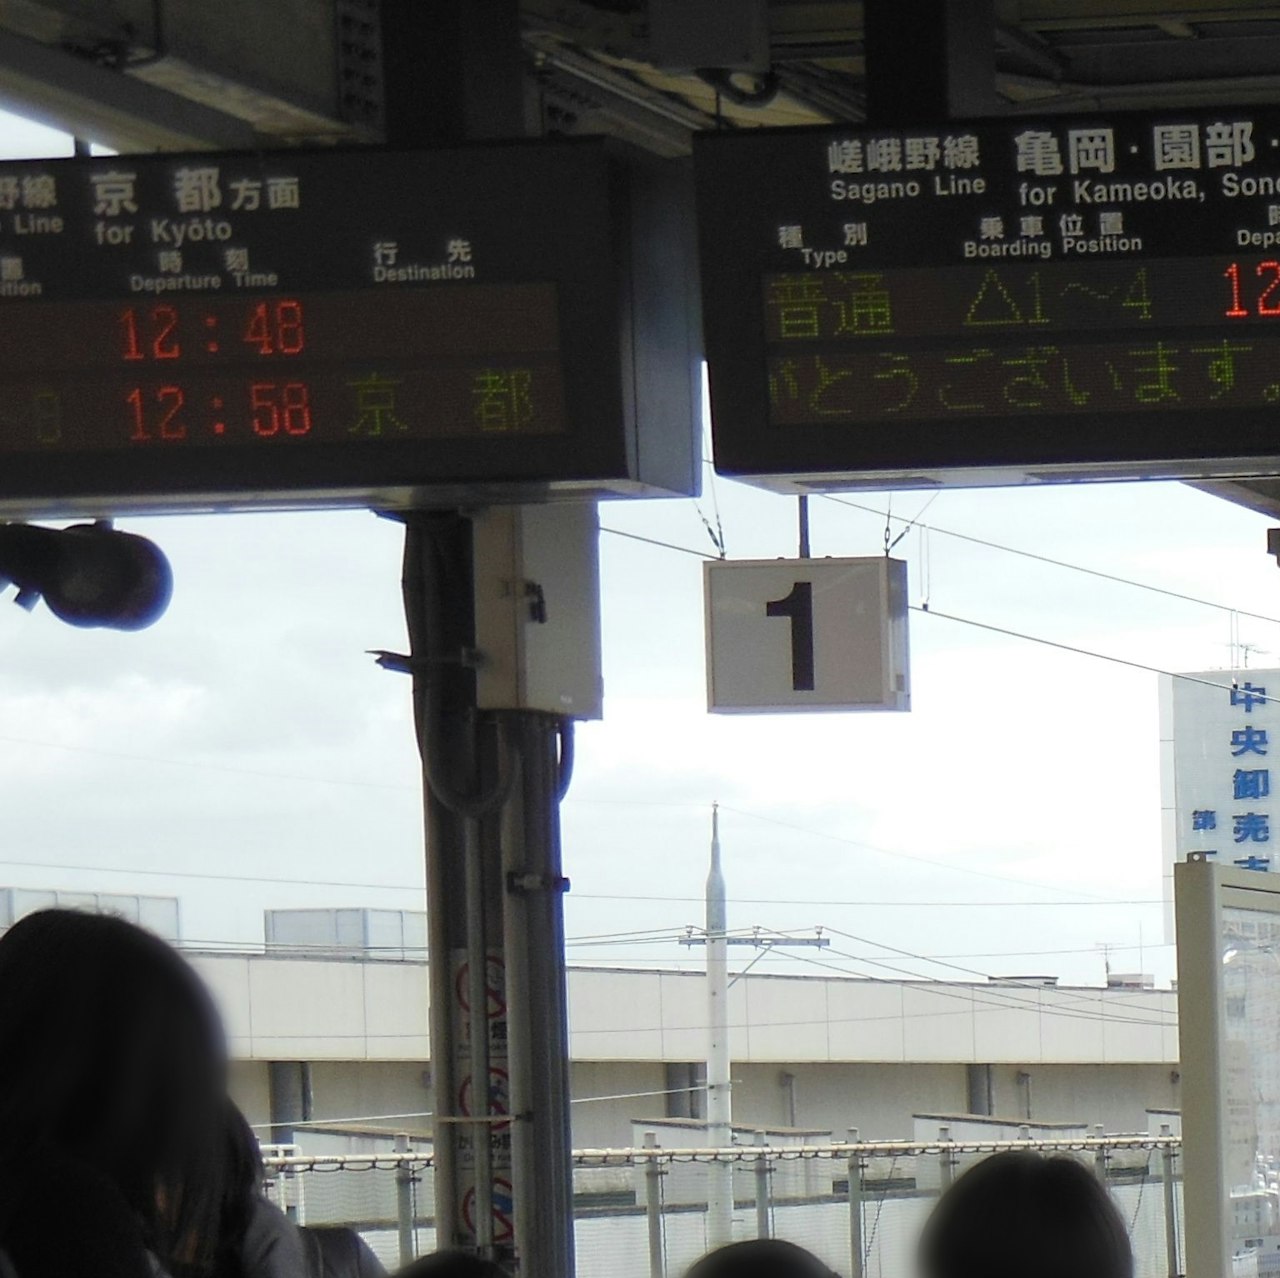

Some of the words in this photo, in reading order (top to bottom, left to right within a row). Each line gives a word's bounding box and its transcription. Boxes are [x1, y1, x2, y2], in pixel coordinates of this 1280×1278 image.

[828, 135, 980, 174] 嵯峨野線
[831, 179, 920, 202] Sagano
[935, 174, 986, 197] Line
[1020, 181, 1056, 205] for
[1074, 177, 1206, 205] Kameoka,
[15, 213, 64, 236] Line
[96, 221, 134, 245] for
[801, 247, 848, 269] Type
[964, 237, 1052, 259] Boarding
[1063, 234, 1143, 255] Position
[131, 274, 222, 293] Departure
[233, 271, 278, 287] Time
[374, 262, 475, 282] Destination
[768, 271, 896, 337] 普通
[766, 582, 814, 691] 1
